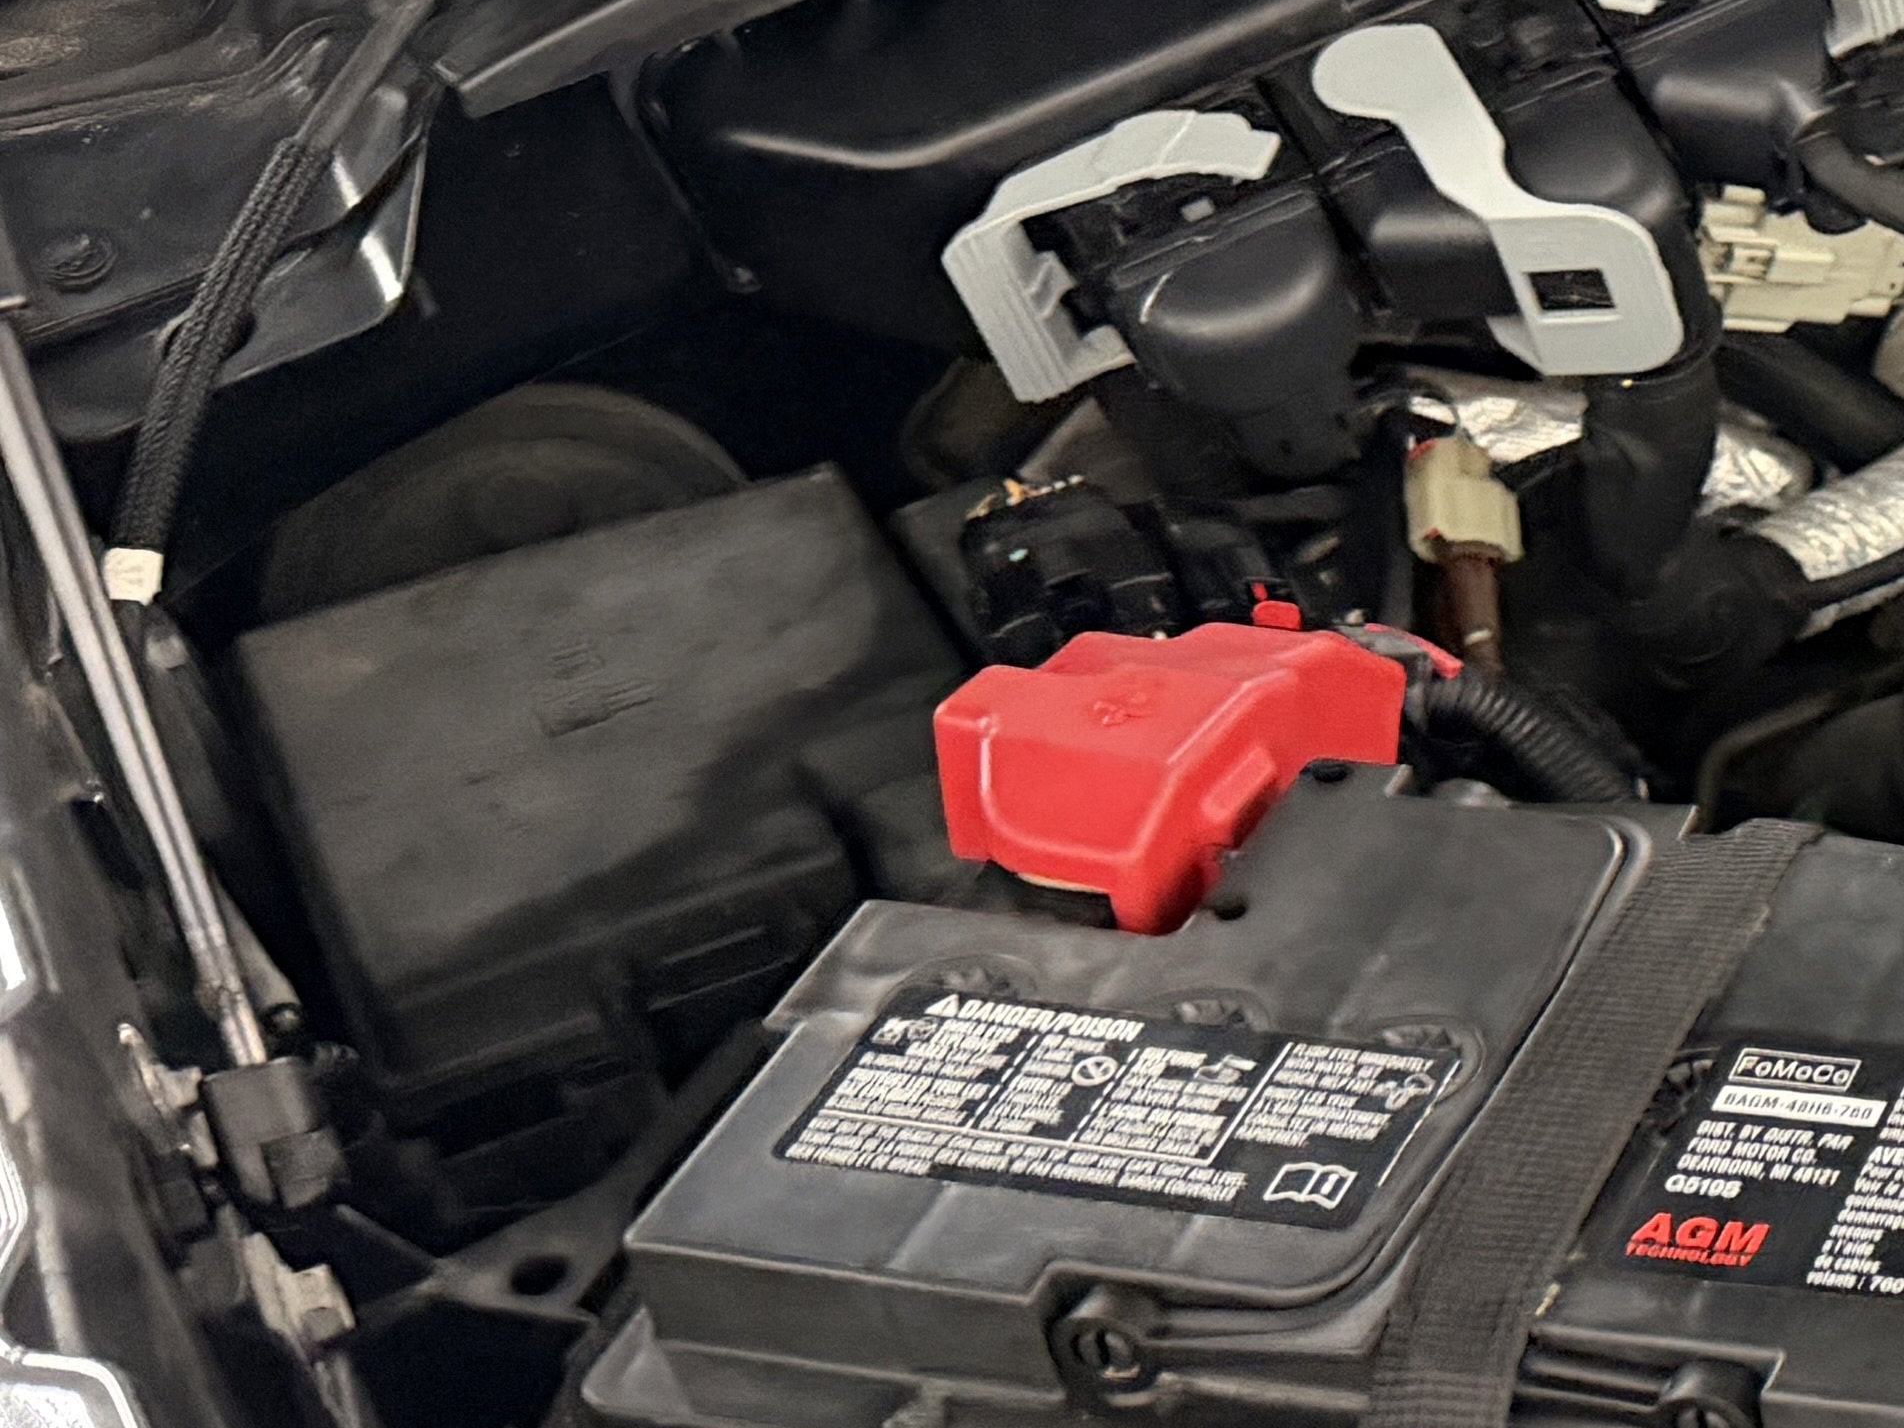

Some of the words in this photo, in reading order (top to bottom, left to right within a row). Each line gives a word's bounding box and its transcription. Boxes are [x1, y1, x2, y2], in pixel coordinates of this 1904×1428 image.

[958, 999, 1145, 1042] DANGER/POISON
[1736, 1056, 1850, 1085] FoMoCo
[1739, 1124, 1763, 1139] BY
[1687, 1137, 1730, 1156] FORD
[1732, 1141, 1791, 1161] MOTOR
[1770, 1164, 1791, 1180] MI
[1631, 1212, 1771, 1254] AGM
[1626, 1242, 1754, 1267] TECHNOLOGY
